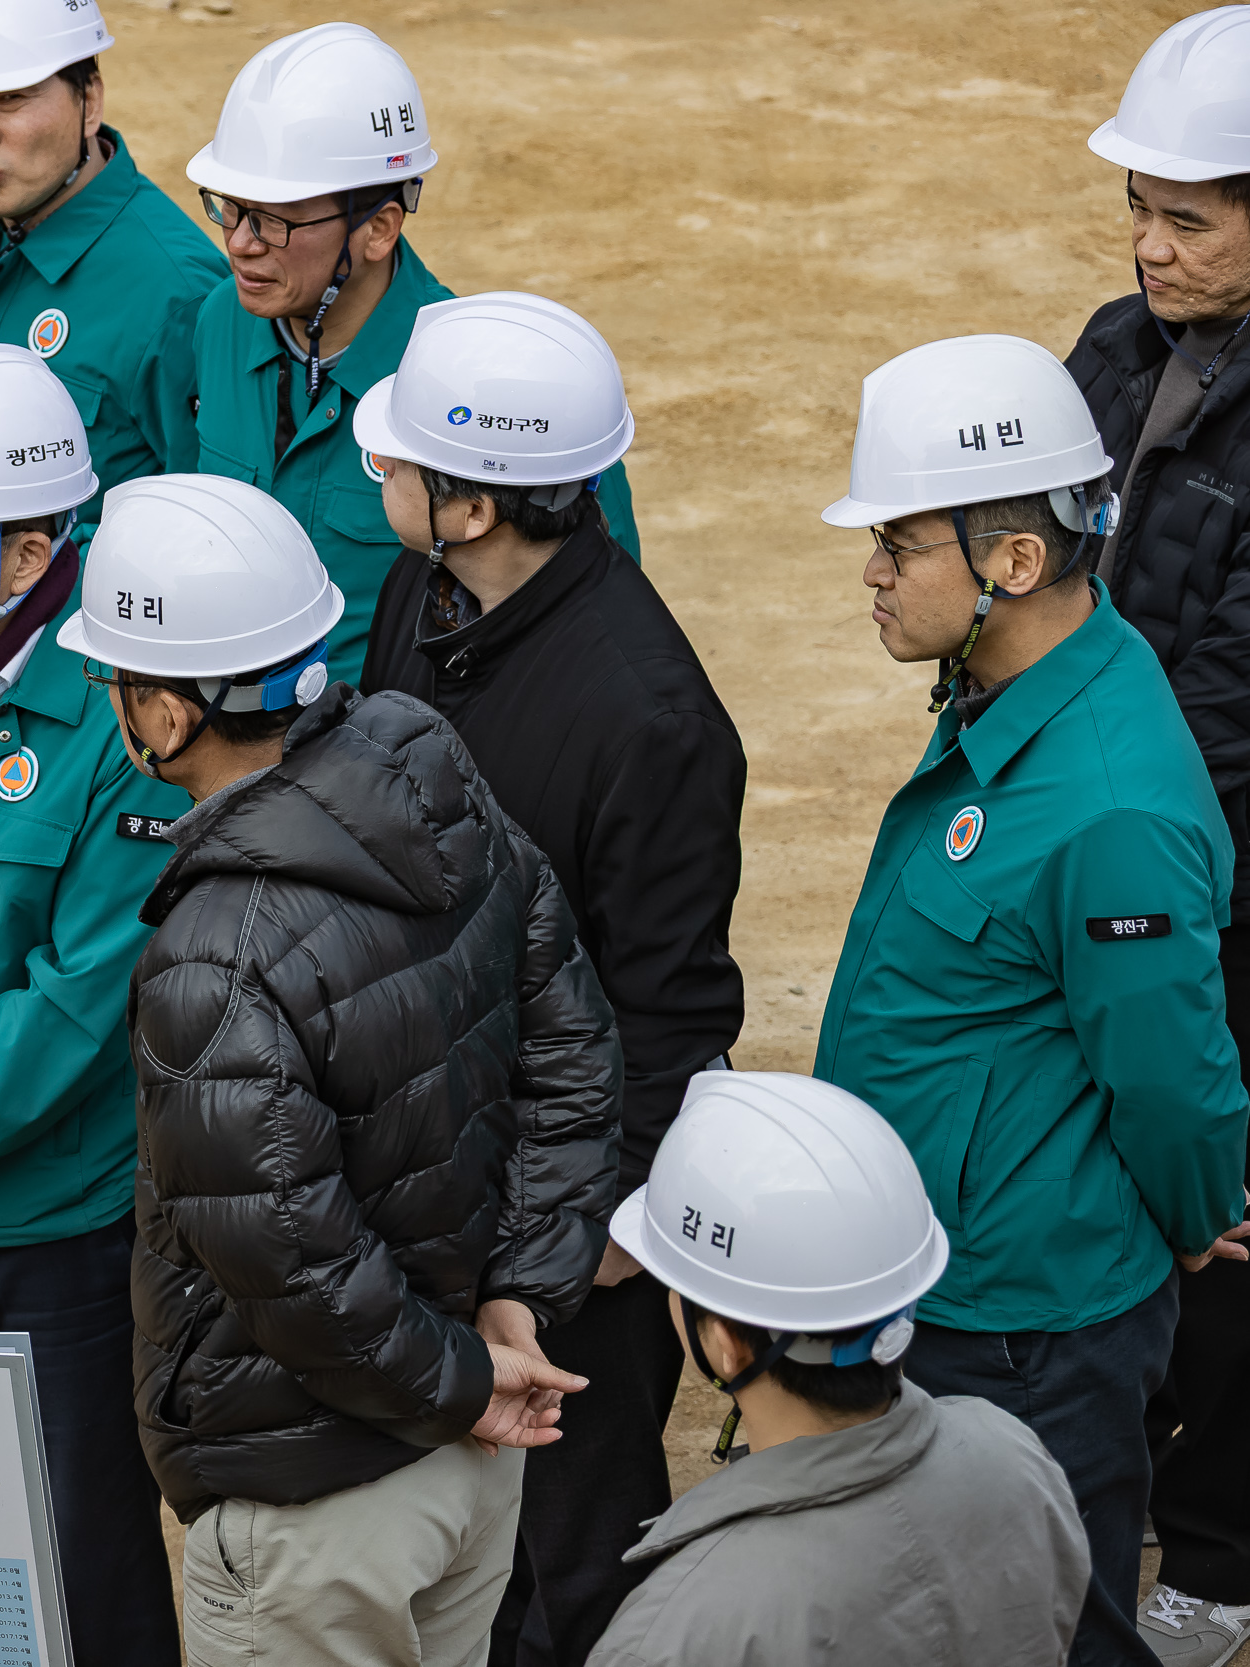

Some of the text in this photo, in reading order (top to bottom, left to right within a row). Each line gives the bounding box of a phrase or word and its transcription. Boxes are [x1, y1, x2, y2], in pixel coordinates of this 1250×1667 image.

[476, 413, 549, 434] 광진구청
[5, 438, 75, 467] 광진구청
[1110, 918, 1149, 935] 광진구
[203, 1596, 235, 1611] EIDER
